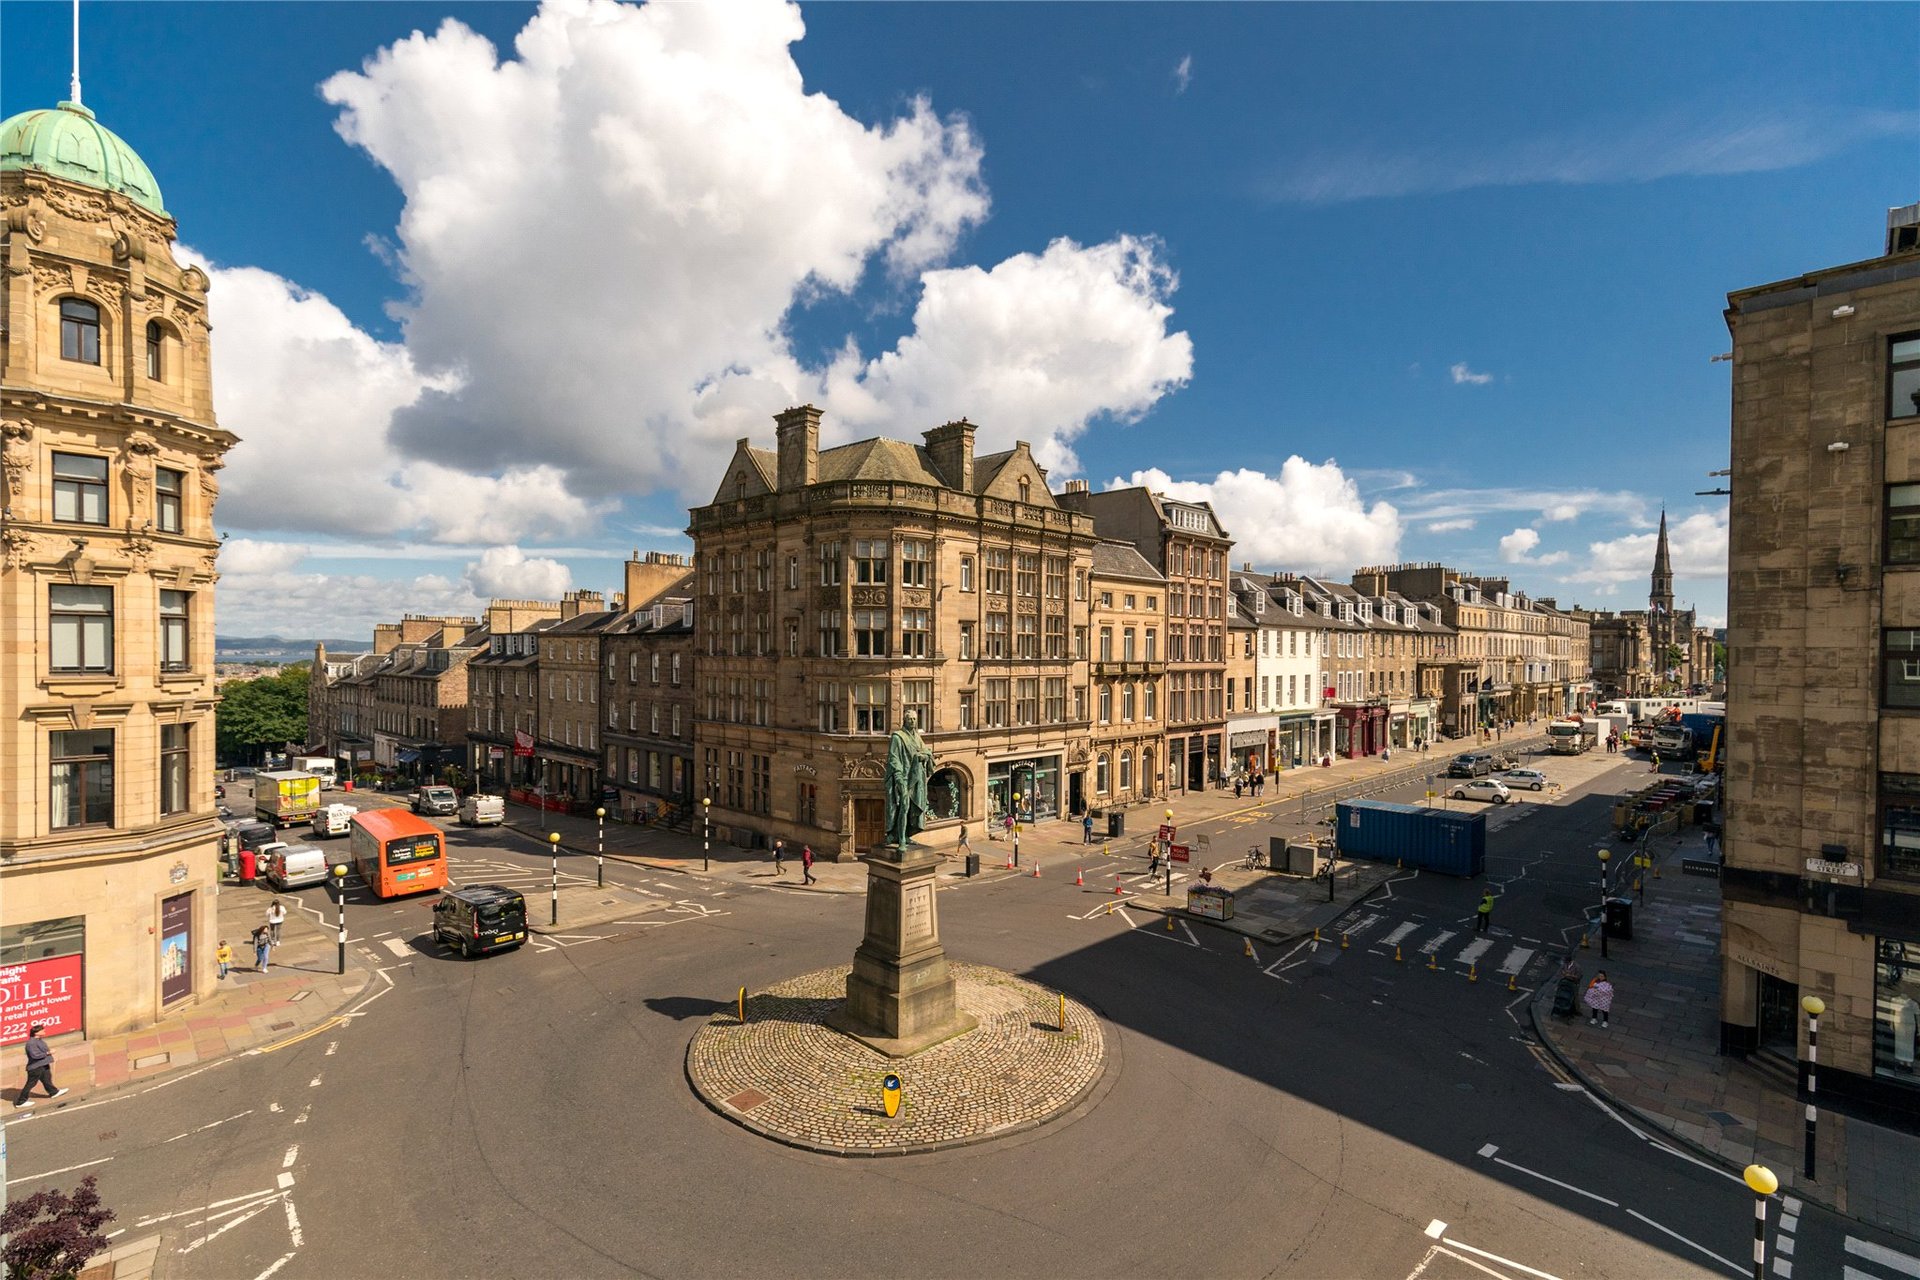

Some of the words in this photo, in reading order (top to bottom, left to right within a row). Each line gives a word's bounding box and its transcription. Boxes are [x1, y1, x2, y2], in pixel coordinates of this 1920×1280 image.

[1684, 865, 1716, 873] ALLSAINTS
[1817, 865, 1846, 875] STREET
[909, 895, 927, 905] PITT
[0, 965, 27, 977] night
[1736, 954, 1780, 976] ALLSAINTS
[0, 975, 21, 984] ank
[23, 975, 73, 1001] LET
[5, 1003, 23, 1013] and
[26, 999, 45, 1010] part
[47, 994, 72, 1004] lower
[4, 1010, 28, 1021] retail
[30, 1007, 48, 1016] unit
[3, 1022, 27, 1036] 222
[30, 1015, 62, 1028] 9601
